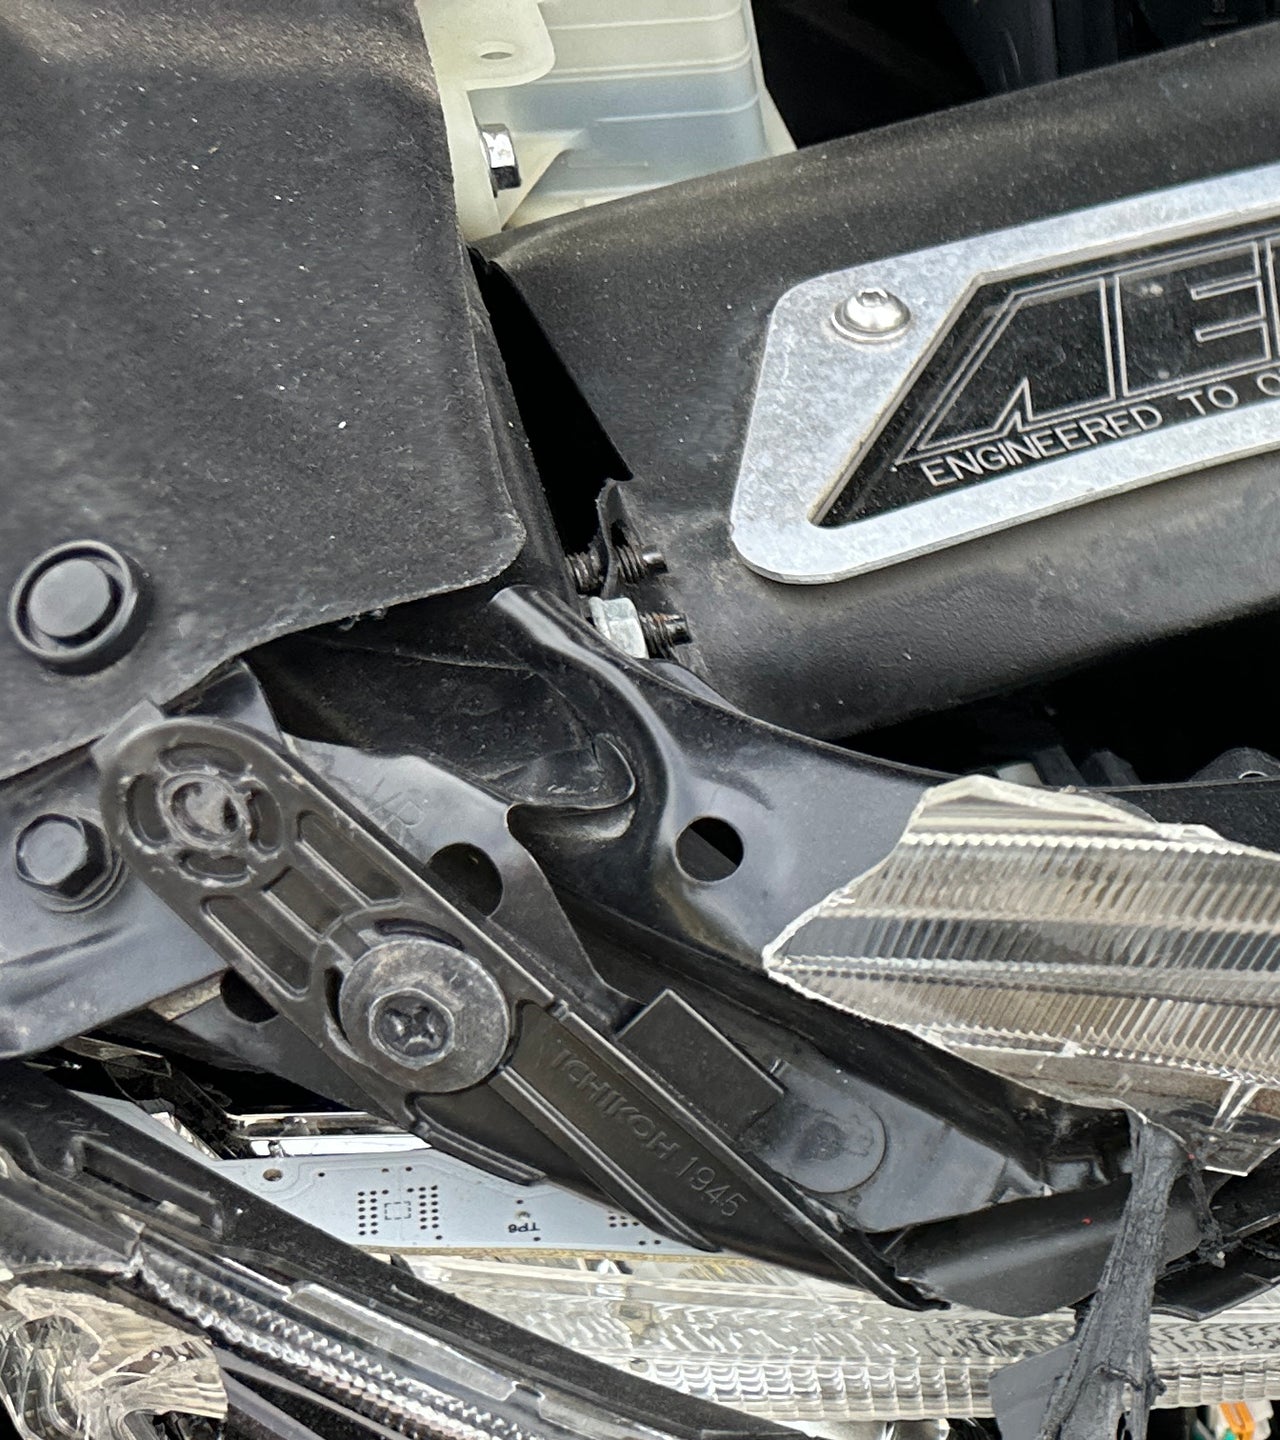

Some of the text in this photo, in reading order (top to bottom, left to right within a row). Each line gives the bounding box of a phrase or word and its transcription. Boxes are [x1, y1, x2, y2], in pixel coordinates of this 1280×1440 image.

[919, 404, 1163, 487] ENGINEERED
[1176, 384, 1239, 416] TO
[551, 1050, 748, 1217] ICHIKOH 1945
